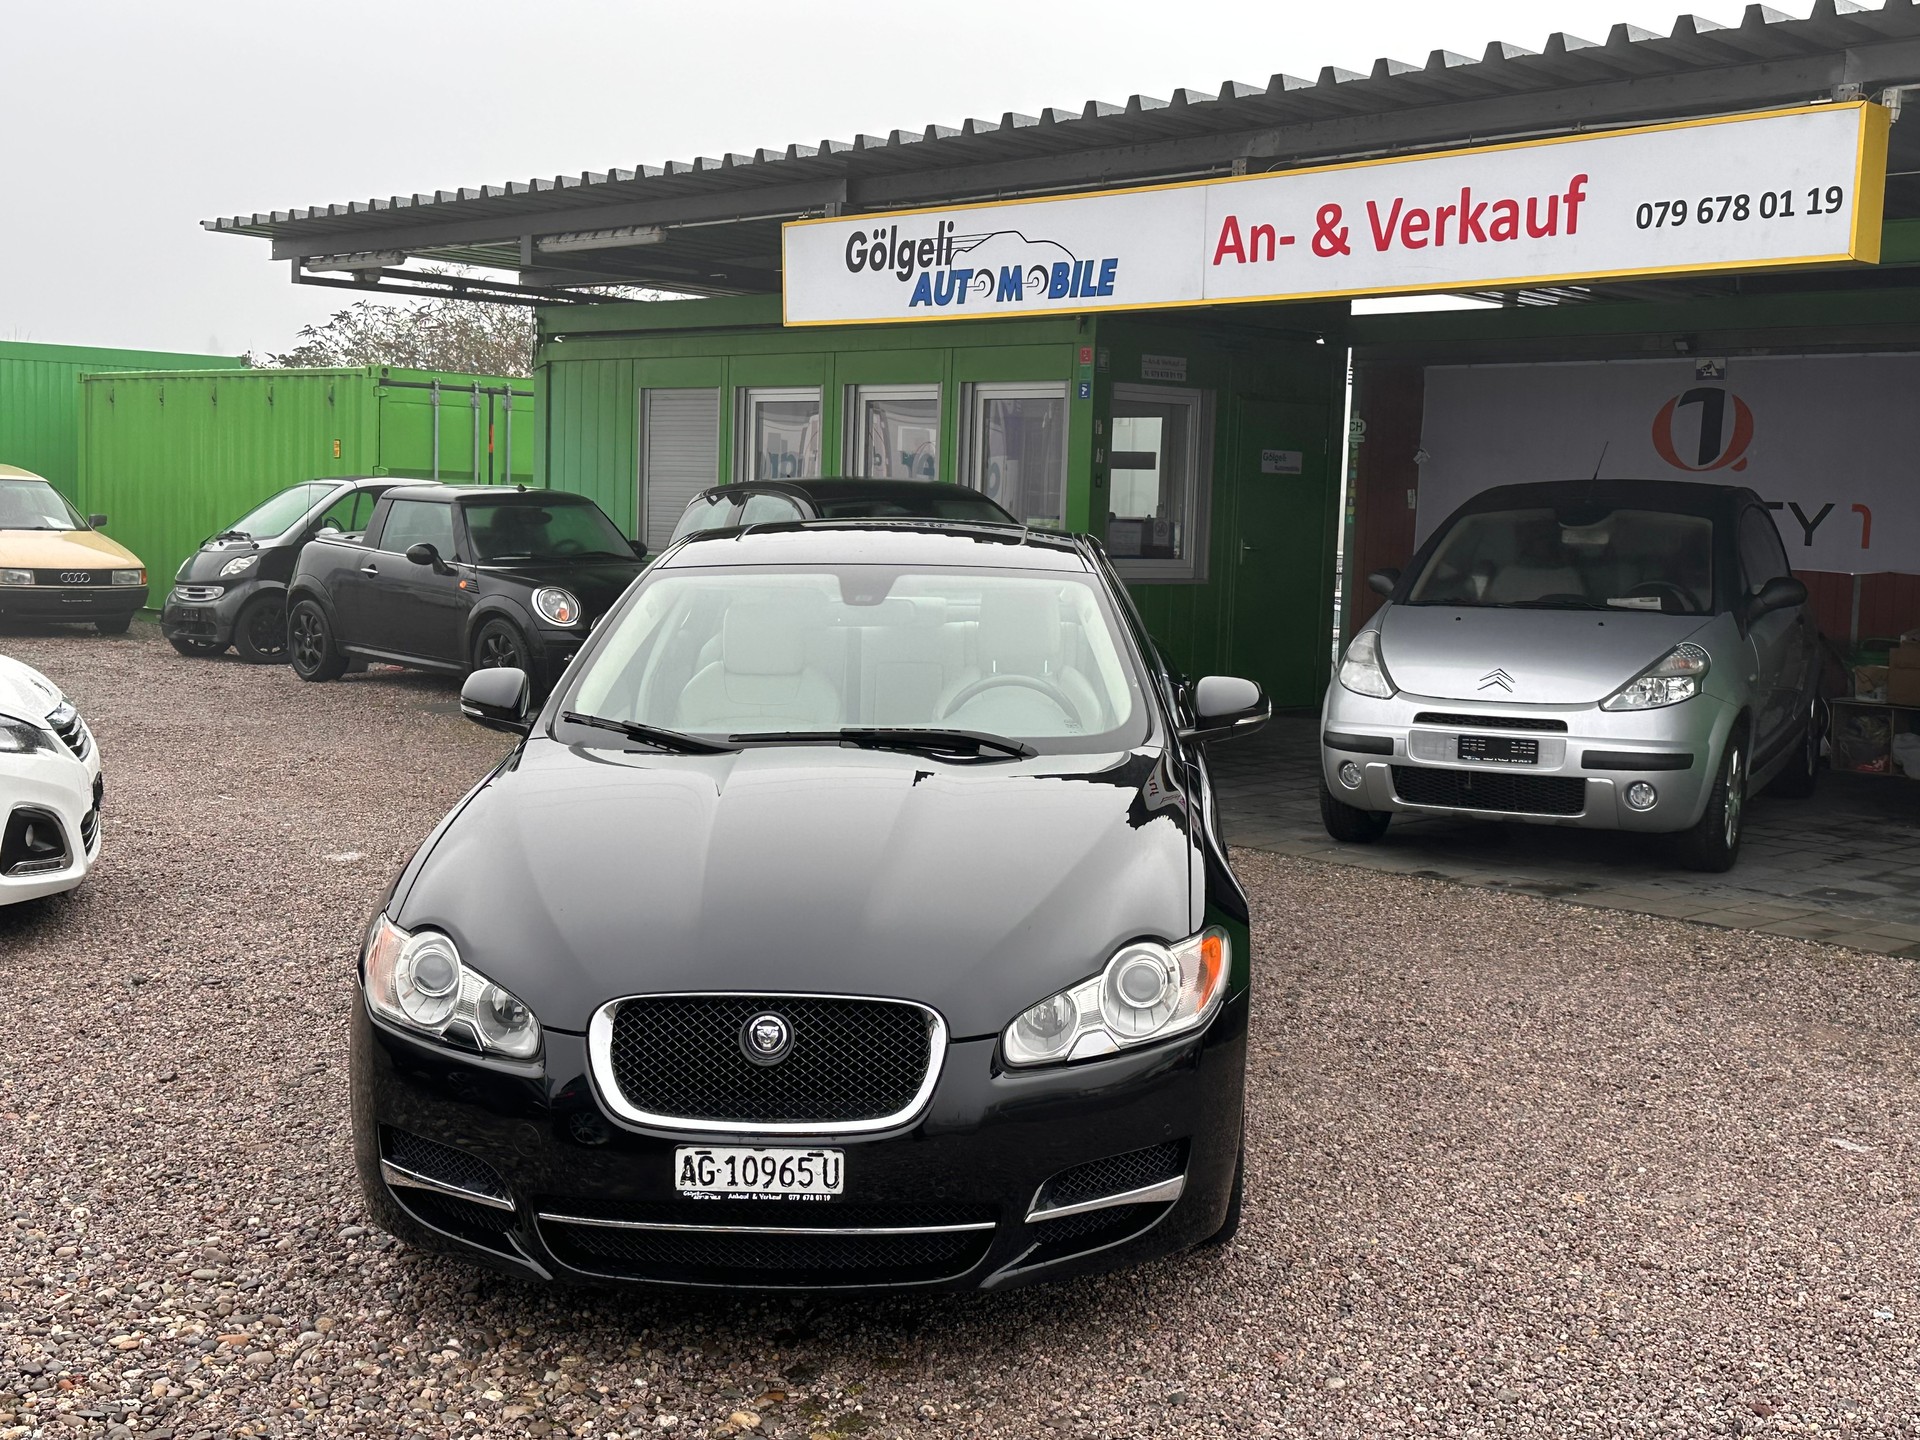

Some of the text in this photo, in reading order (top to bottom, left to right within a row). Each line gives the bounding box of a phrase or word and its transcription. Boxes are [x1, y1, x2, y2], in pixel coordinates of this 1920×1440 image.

[1213, 173, 1588, 265] An- & Verkauf
[1636, 185, 1843, 229] 079 678 01 19
[845, 220, 954, 282] Gölgeli
[1350, 421, 1363, 432] CH
